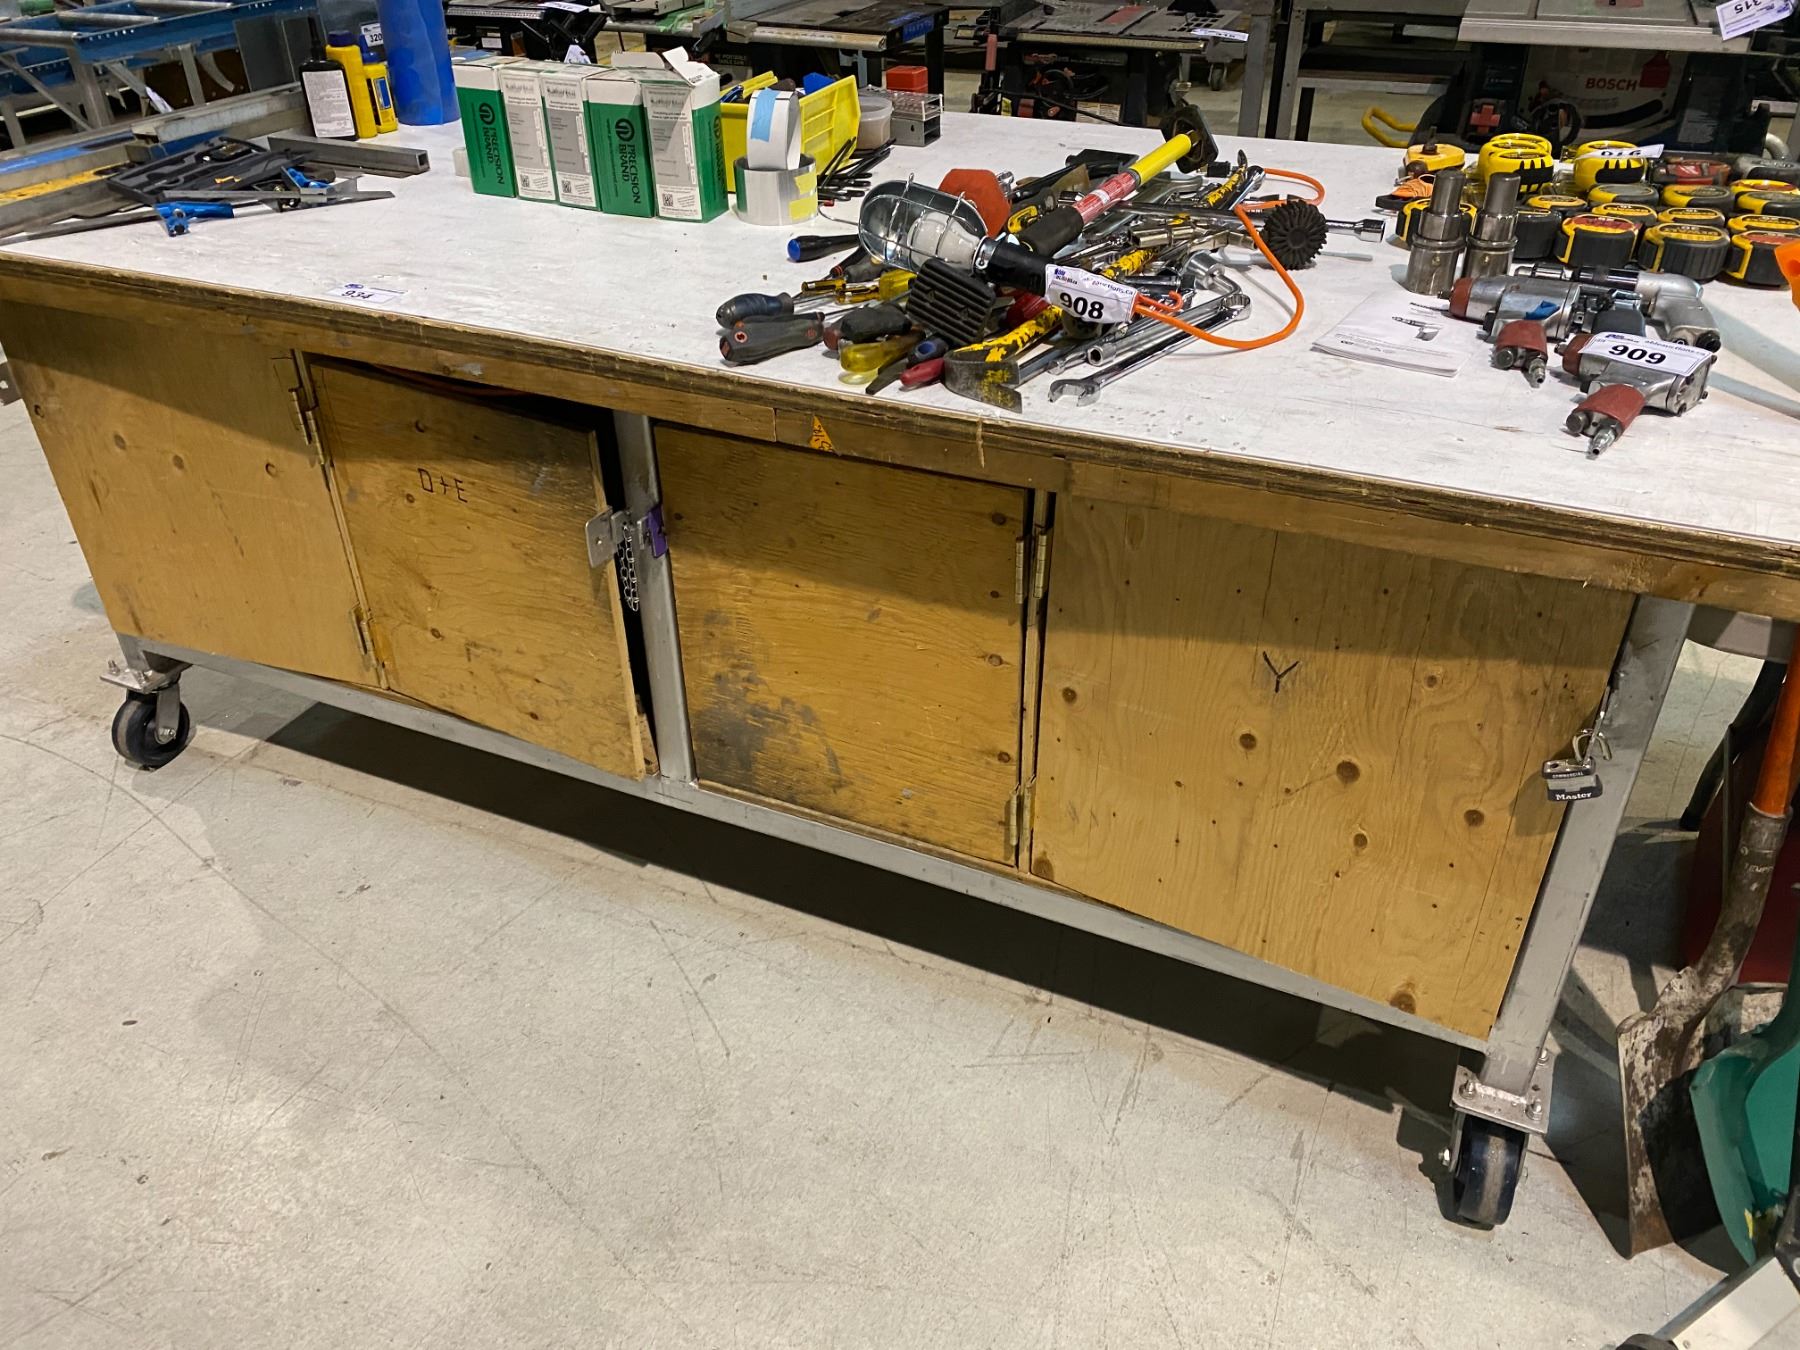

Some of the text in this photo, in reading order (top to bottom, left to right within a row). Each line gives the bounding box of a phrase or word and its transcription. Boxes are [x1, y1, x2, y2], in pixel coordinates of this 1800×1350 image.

[1734, 0, 1762, 14] 315
[370, 33, 383, 43] 320
[1585, 77, 1638, 92] BOSCH
[482, 126, 495, 164] BRAND
[489, 126, 505, 185] PRECISION
[618, 143, 631, 182] BRAND
[626, 143, 642, 204] PRECISION
[341, 290, 374, 299] 934
[1059, 292, 1105, 320] 908
[1608, 344, 1667, 365] 909
[417, 467, 468, 503] D+E
[1262, 650, 1300, 693] Y
[1555, 791, 1592, 801] Master
